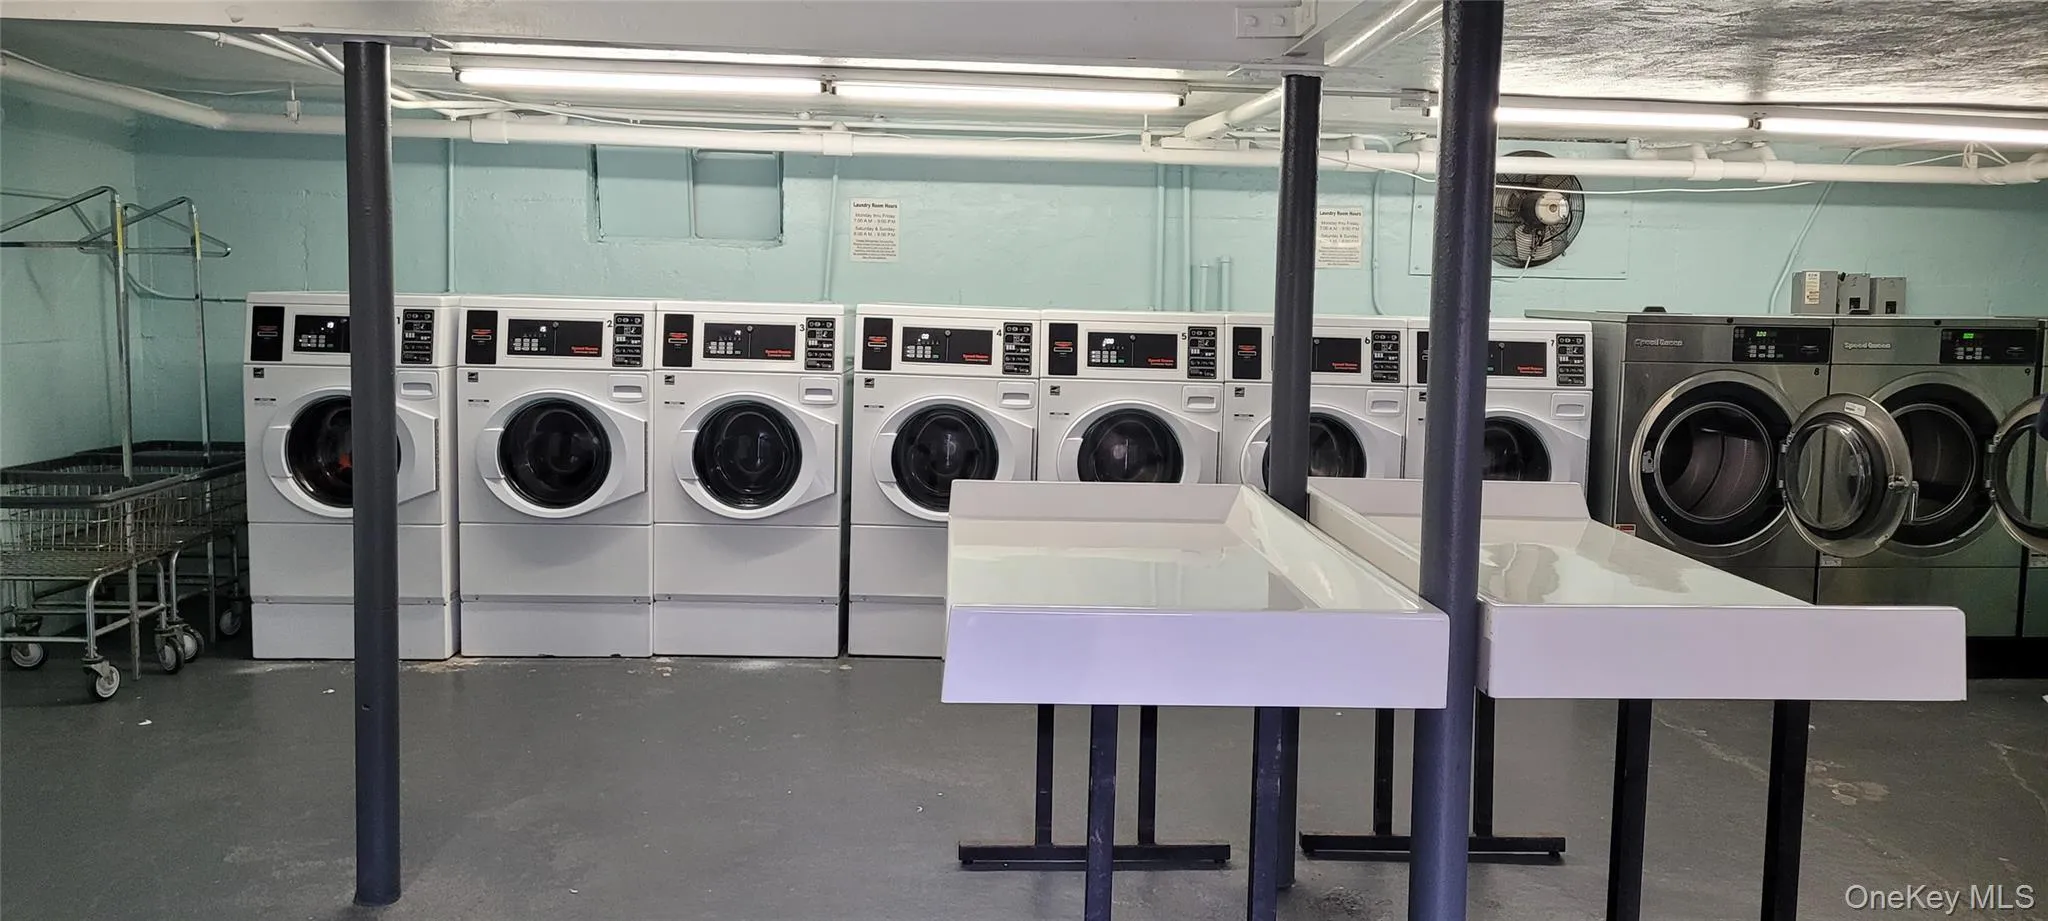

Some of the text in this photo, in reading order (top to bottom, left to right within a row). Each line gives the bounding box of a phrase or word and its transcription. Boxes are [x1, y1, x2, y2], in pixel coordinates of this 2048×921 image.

[607, 320, 613, 328] 2
[799, 324, 805, 332] 3
[996, 329, 1002, 338] 4
[1181, 333, 1187, 341] 5
[1364, 337, 1371, 345] 6
[1550, 340, 1555, 348] 7
[1843, 342, 1867, 350] Speed
[1813, 368, 1820, 376] 8
[2025, 368, 2031, 376] 9
